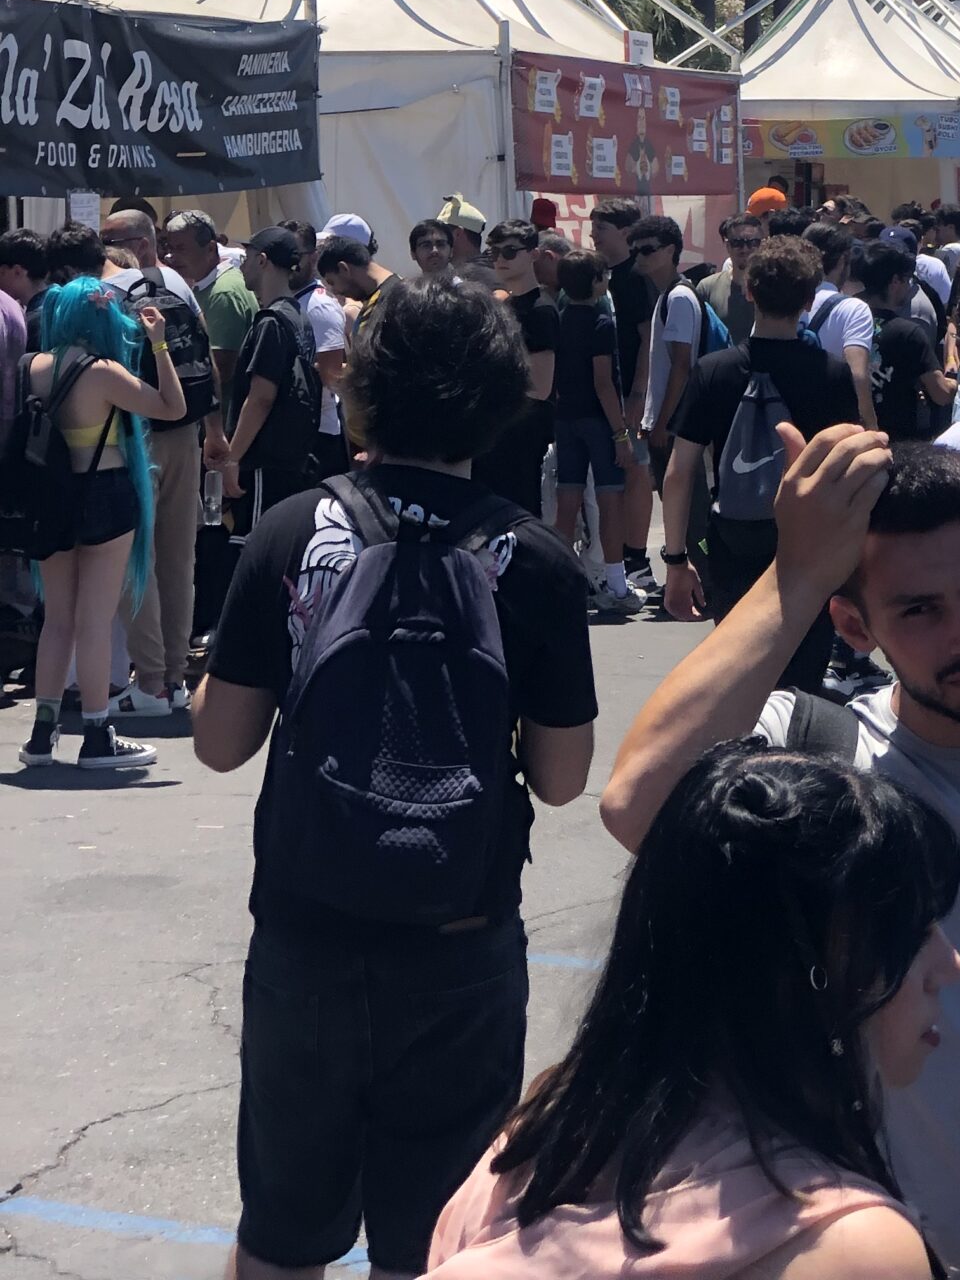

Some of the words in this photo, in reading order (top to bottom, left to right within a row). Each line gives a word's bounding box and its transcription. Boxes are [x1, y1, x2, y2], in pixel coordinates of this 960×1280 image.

[236, 51, 291, 76] PANINERIA
[118, 50, 203, 133] Rosa
[221, 89, 298, 117] CARNEZZERIA
[35, 141, 77, 167] FOOD
[88, 143, 101, 168] &
[108, 143, 157, 168] DRINKS
[223, 128, 303, 158] HAMBURGERIA
[874, 145, 897, 153] GYOZA
